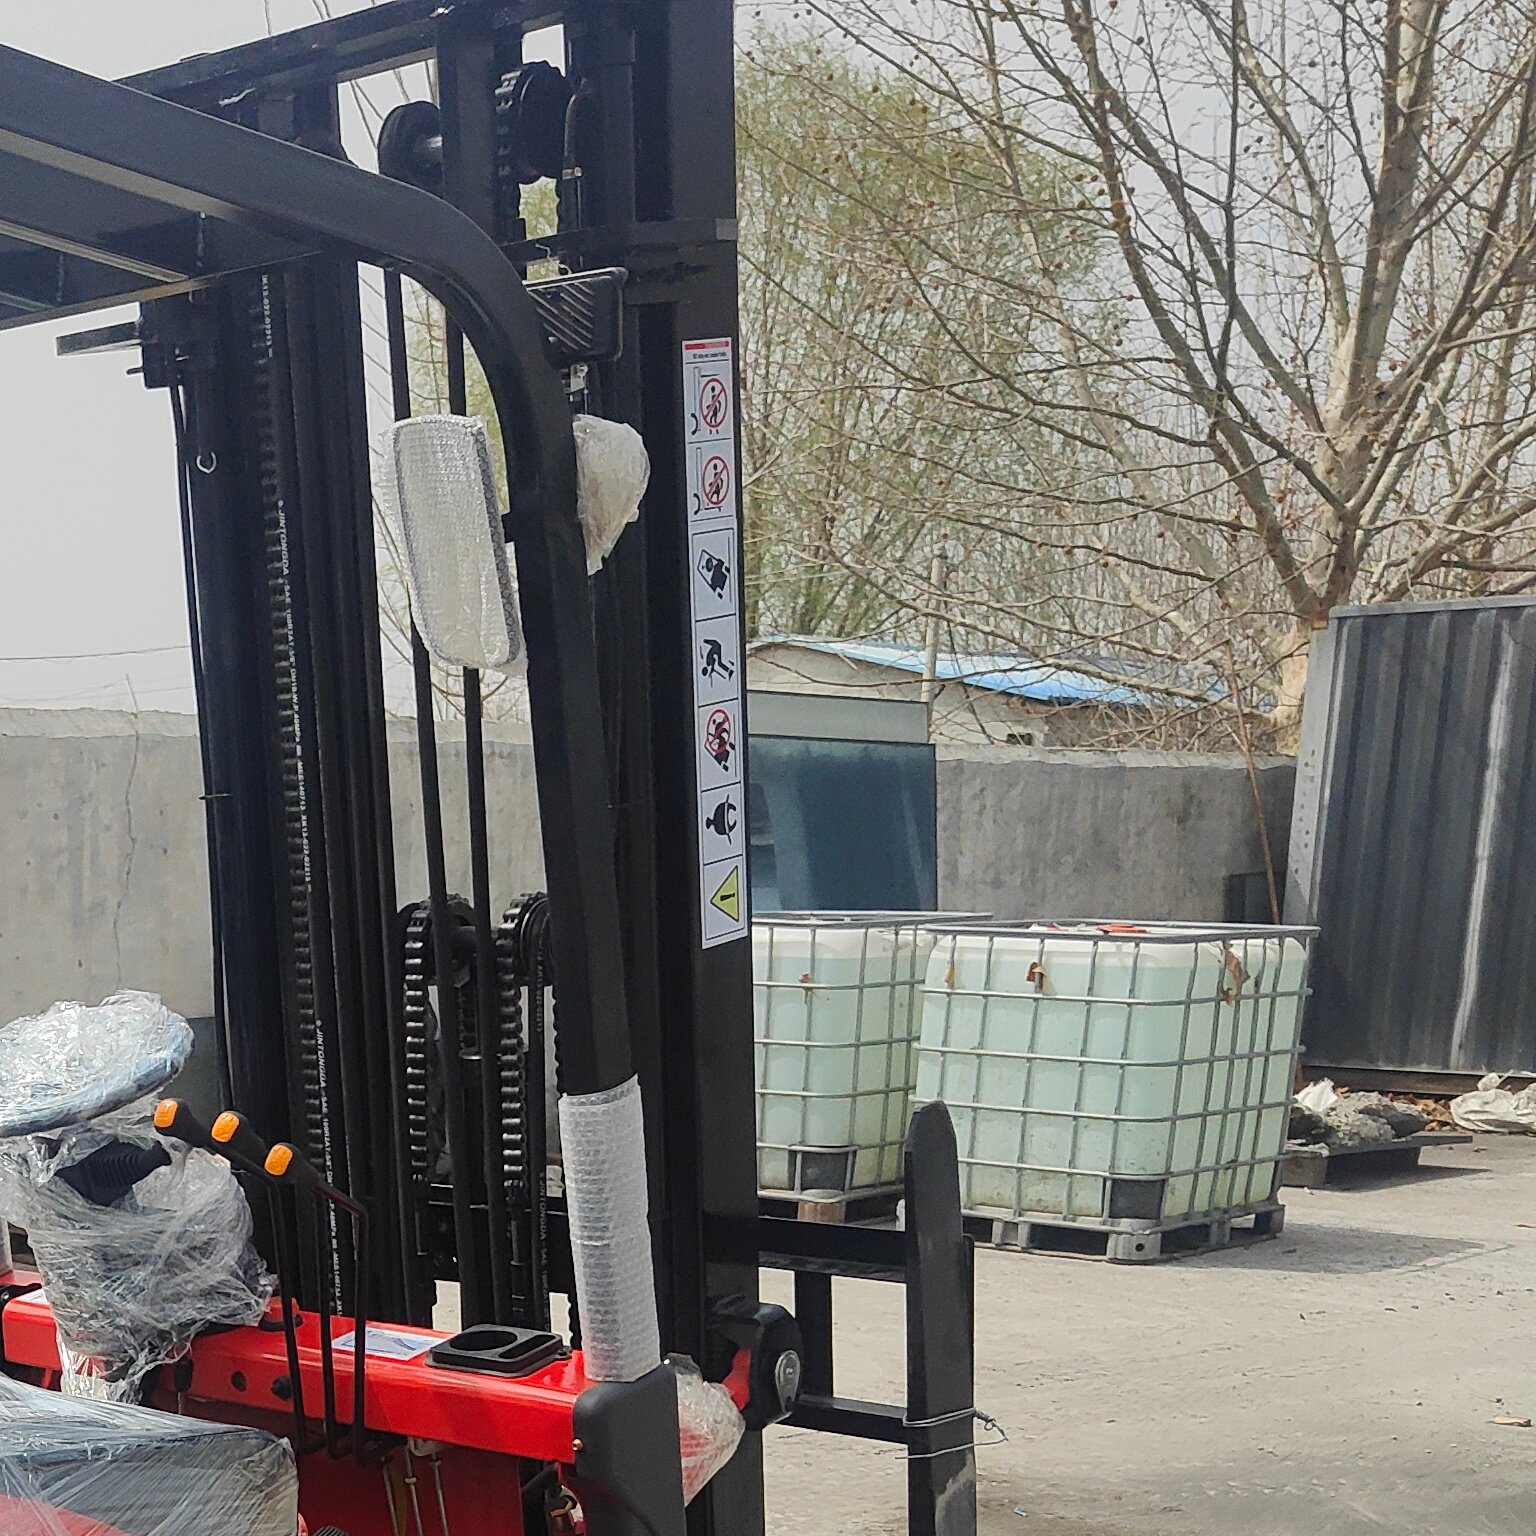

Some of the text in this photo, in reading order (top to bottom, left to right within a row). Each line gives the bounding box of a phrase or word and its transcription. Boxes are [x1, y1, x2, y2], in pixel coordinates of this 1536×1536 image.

[279, 509, 290, 576] JINTONGDA
[316, 1028, 327, 1087] JINTONGDA
[539, 1180, 548, 1240] JINTONGDA
